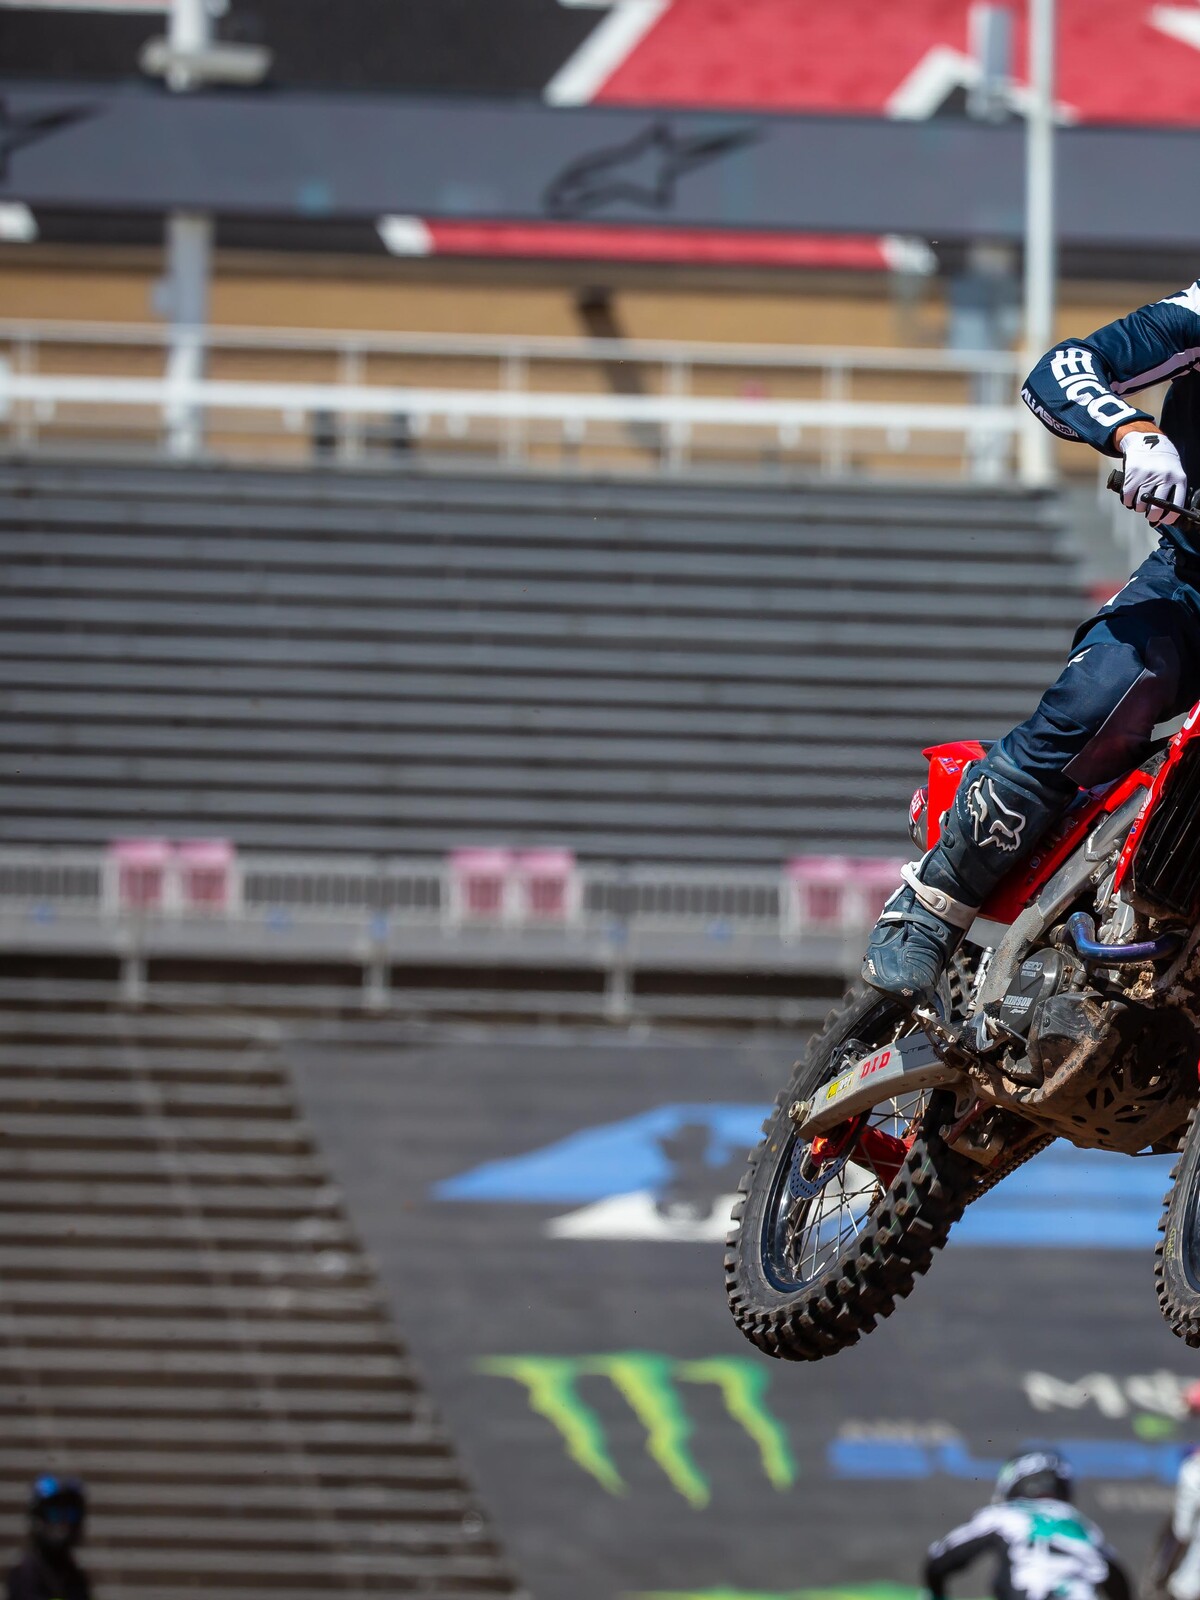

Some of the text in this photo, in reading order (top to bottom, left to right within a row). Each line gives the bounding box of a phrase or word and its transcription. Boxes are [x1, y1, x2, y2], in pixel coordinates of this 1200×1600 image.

[1050, 347, 1137, 427] EICO
[868, 959, 877, 976] FOX
[860, 1051, 890, 1080] DID
